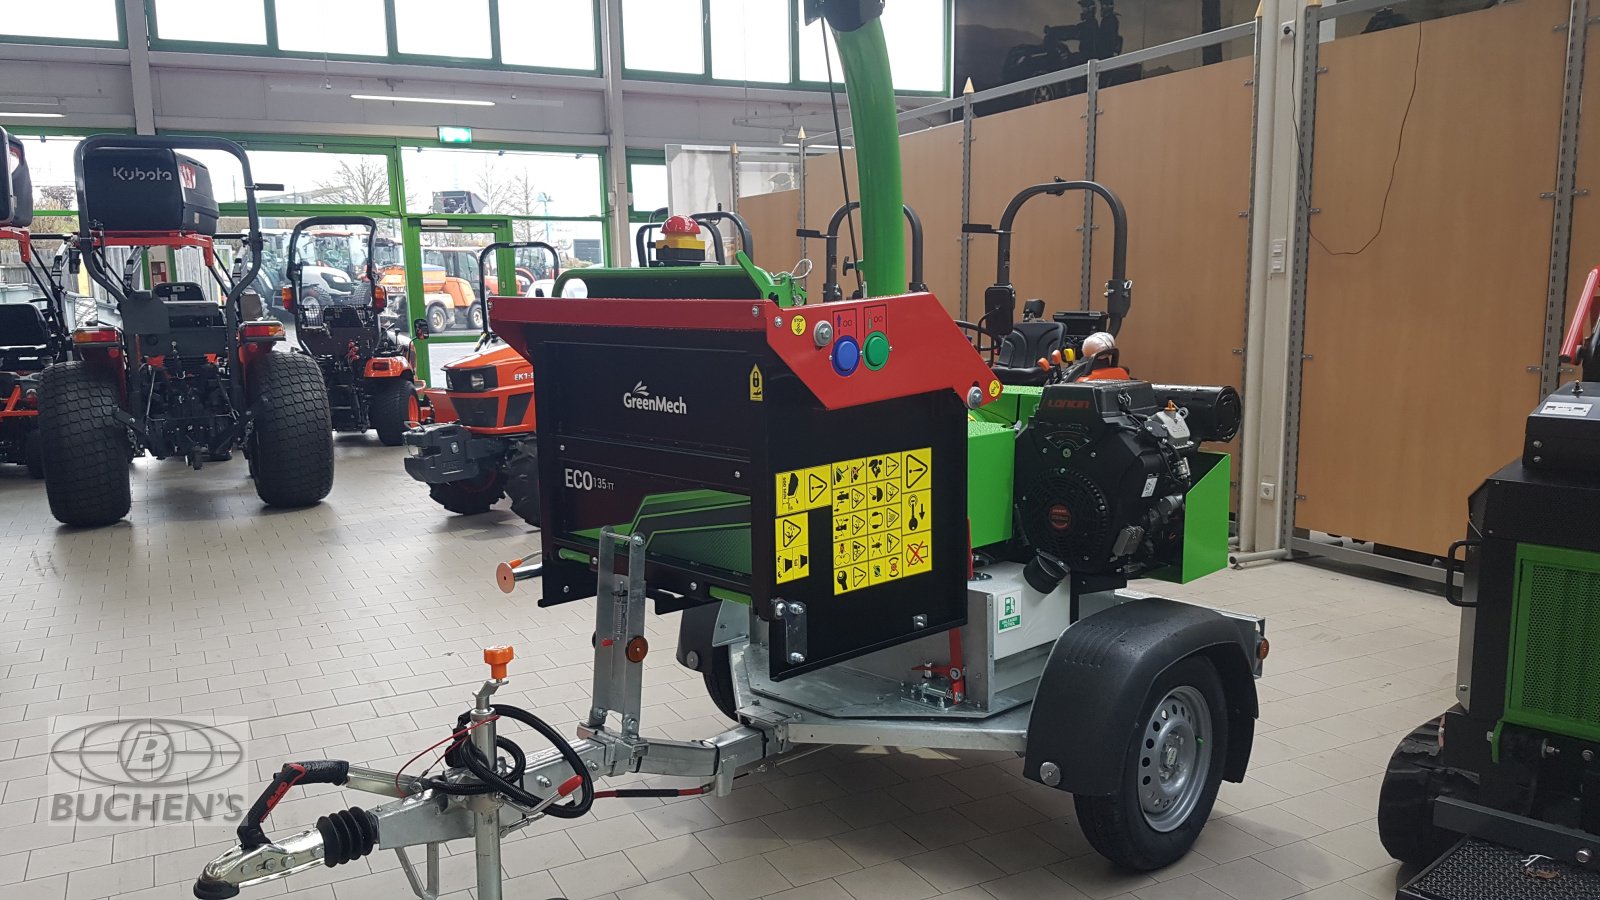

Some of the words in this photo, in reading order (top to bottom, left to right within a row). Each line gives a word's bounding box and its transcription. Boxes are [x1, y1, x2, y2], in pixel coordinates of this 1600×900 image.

[112, 166, 173, 181] Kubota
[623, 391, 688, 415] GreenMech
[564, 467, 593, 491] ECO
